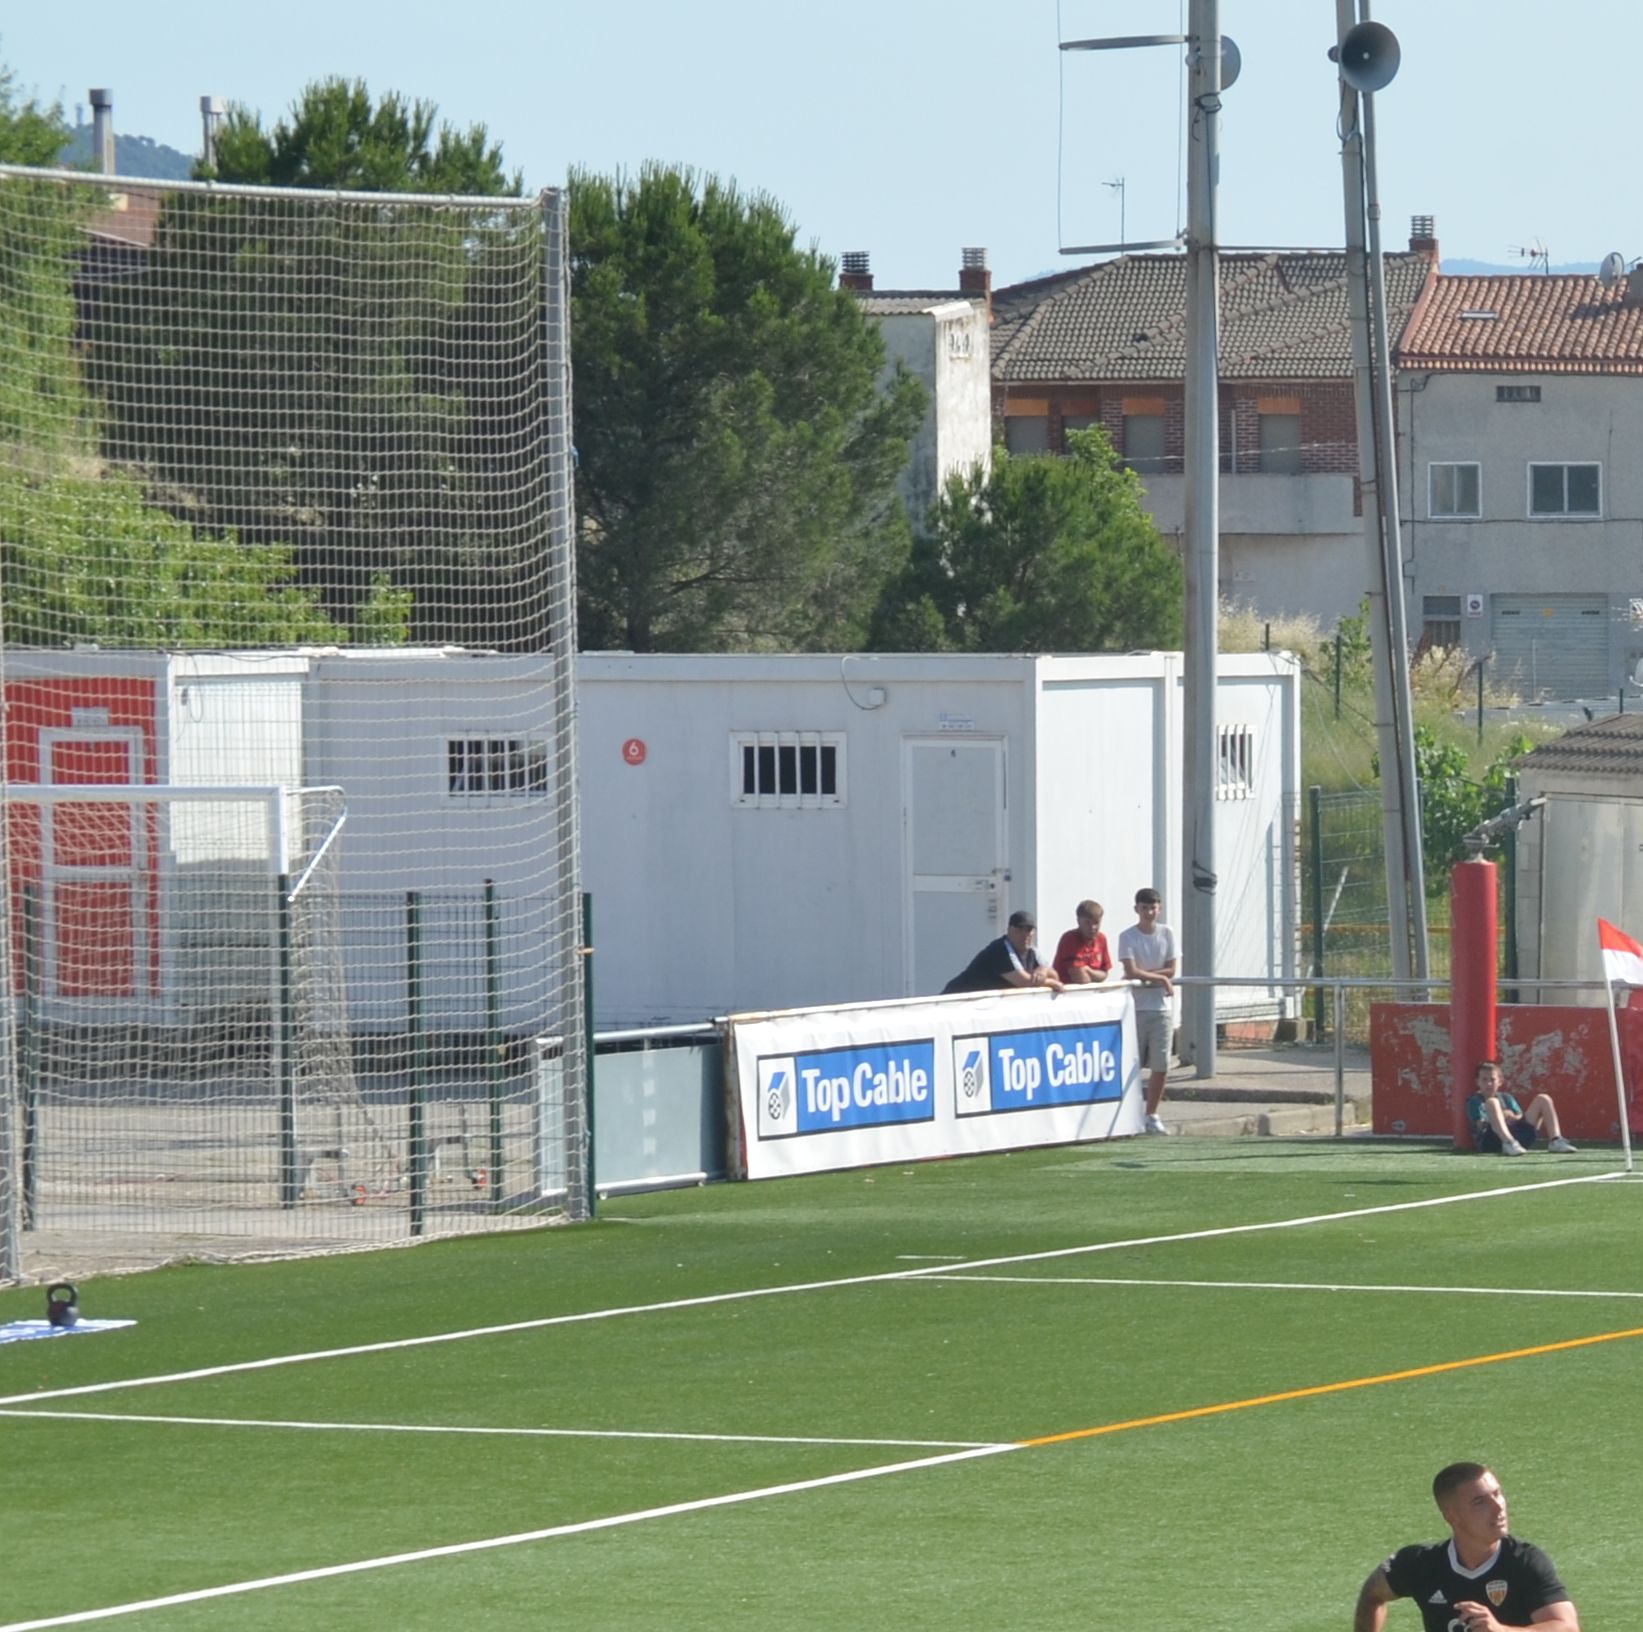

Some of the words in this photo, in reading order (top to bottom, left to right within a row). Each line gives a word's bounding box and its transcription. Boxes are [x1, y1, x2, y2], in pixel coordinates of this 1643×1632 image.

[628, 741, 640, 756] 6
[802, 1068, 849, 1121] Top
[854, 1059, 928, 1107] Cable
[998, 1048, 1041, 1100] Top
[1046, 1040, 1115, 1087] Cable
